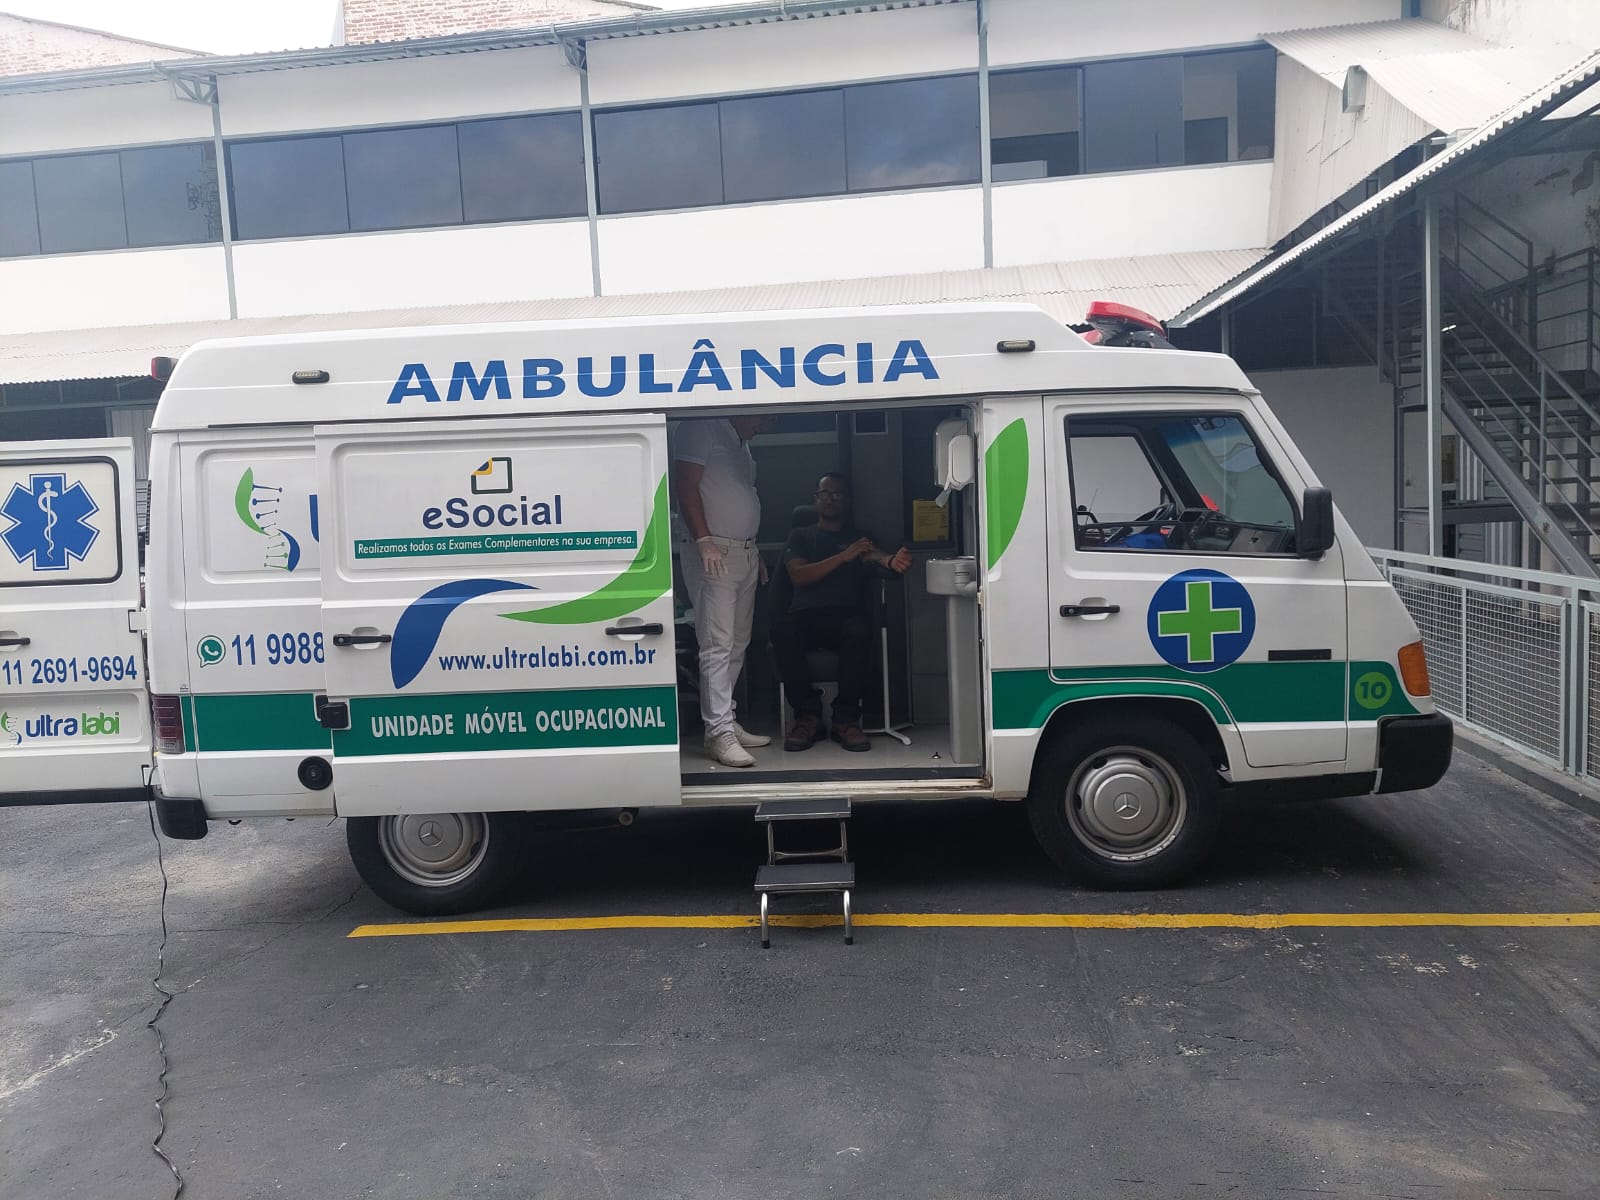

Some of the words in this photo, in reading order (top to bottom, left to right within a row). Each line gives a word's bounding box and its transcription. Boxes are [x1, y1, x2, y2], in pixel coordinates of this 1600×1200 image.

[386, 338, 940, 405] AMBULÂNCIA
[422, 494, 563, 530] eSocial
[358, 542, 408, 554] Realizamos
[409, 540, 434, 552] todos
[436, 541, 447, 551] os
[448, 539, 482, 550] Exames
[484, 535, 560, 550] Complementares
[561, 536, 573, 546] na
[575, 536, 592, 546] sua
[593, 535, 635, 547] empresa.
[231, 634, 258, 666] 11
[266, 631, 325, 666] 9988
[438, 642, 657, 671] www.ultralabi.com.br
[2, 660, 23, 685] 11
[30, 655, 138, 684] 2691-9694
[1359, 681, 1388, 700] 10
[370, 713, 455, 738] UNIDADE
[465, 706, 527, 735] MÓVEL
[535, 706, 666, 733] OCUPACIONAL
